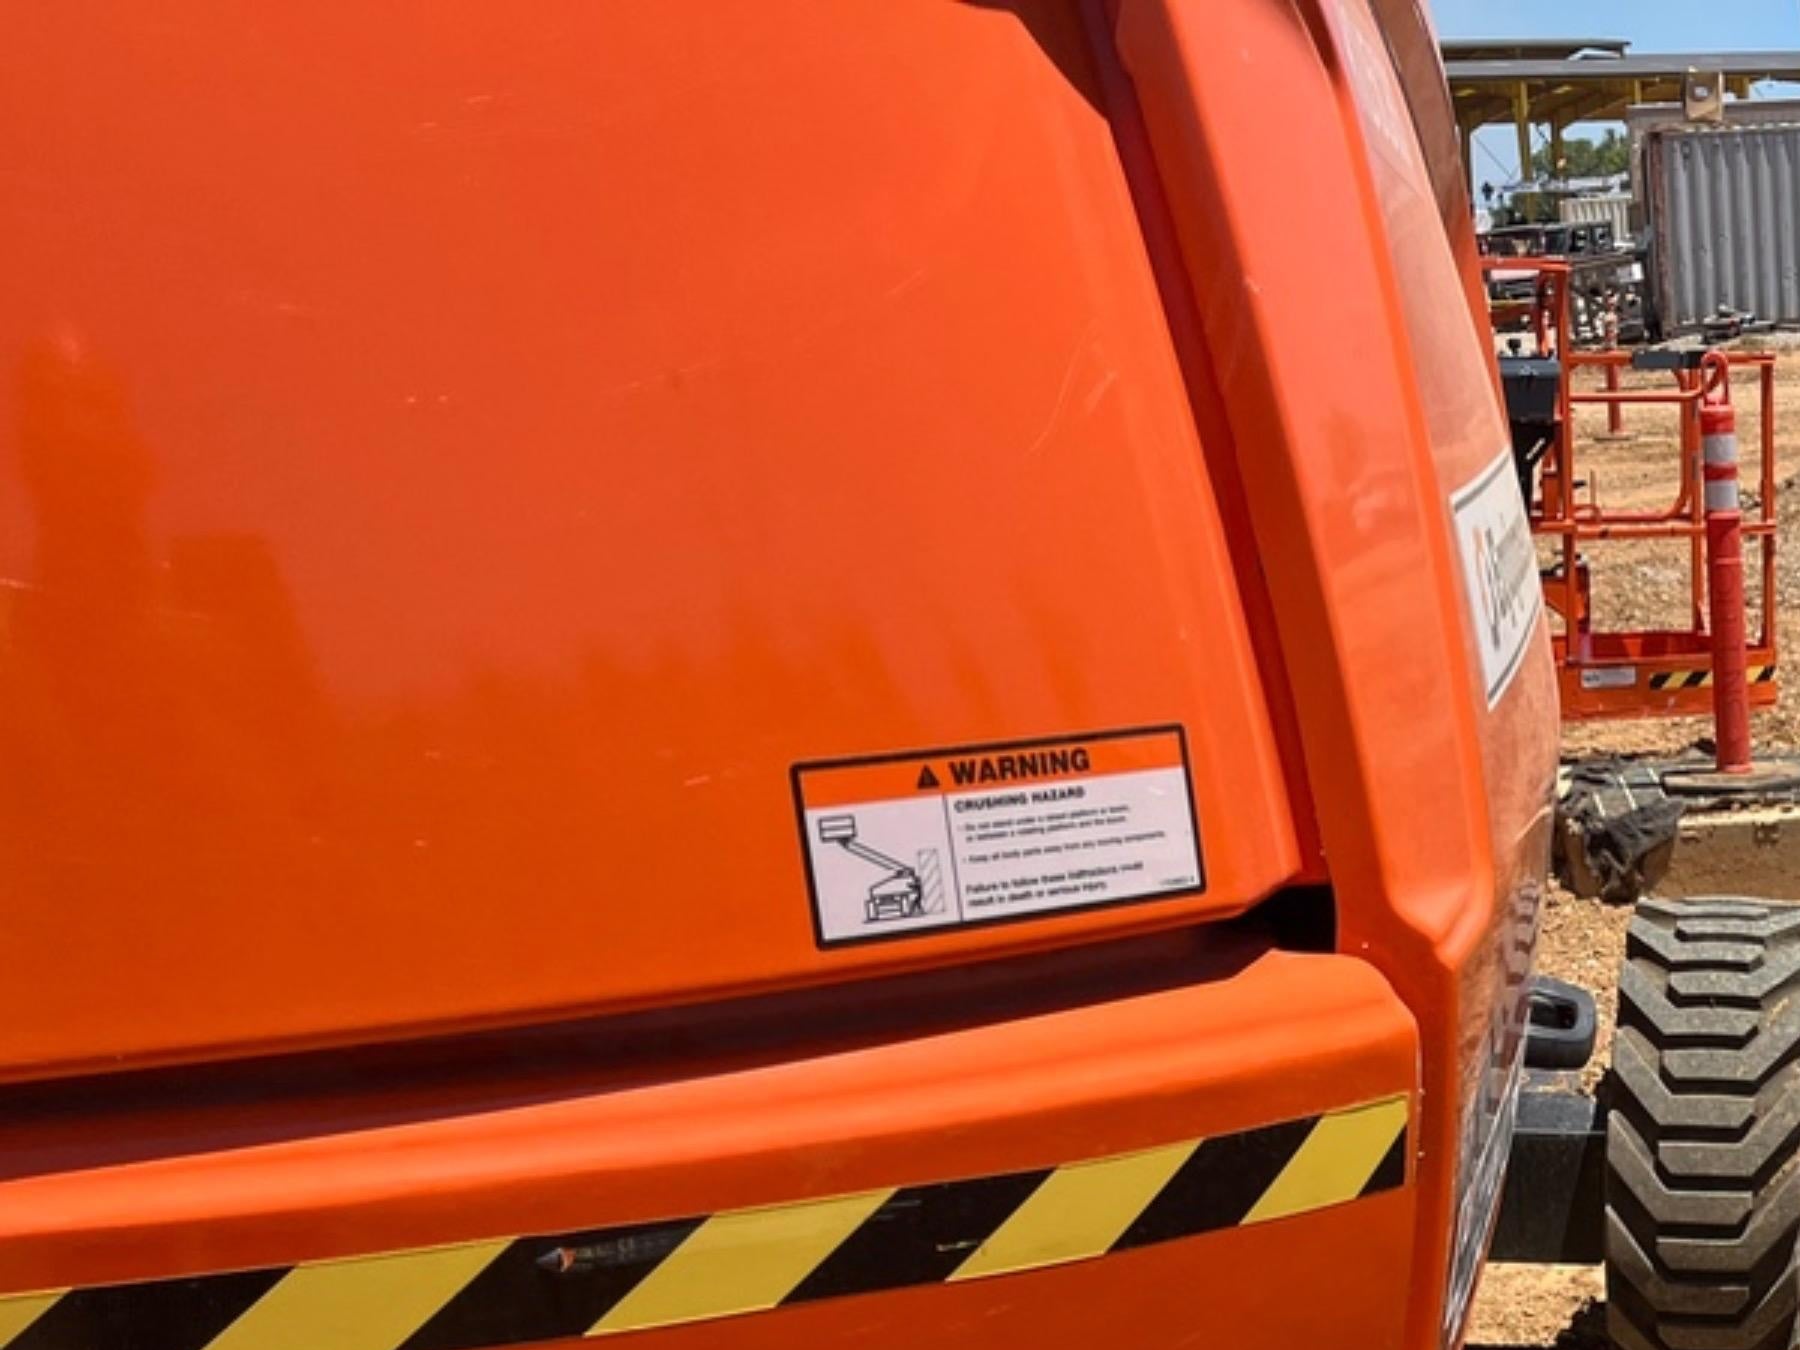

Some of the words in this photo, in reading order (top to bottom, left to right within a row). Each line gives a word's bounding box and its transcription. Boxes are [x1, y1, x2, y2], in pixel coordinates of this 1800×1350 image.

[949, 748, 1089, 785] WARNING
[953, 792, 1027, 812] CRUSHING
[1031, 786, 1084, 802] HAZARD
